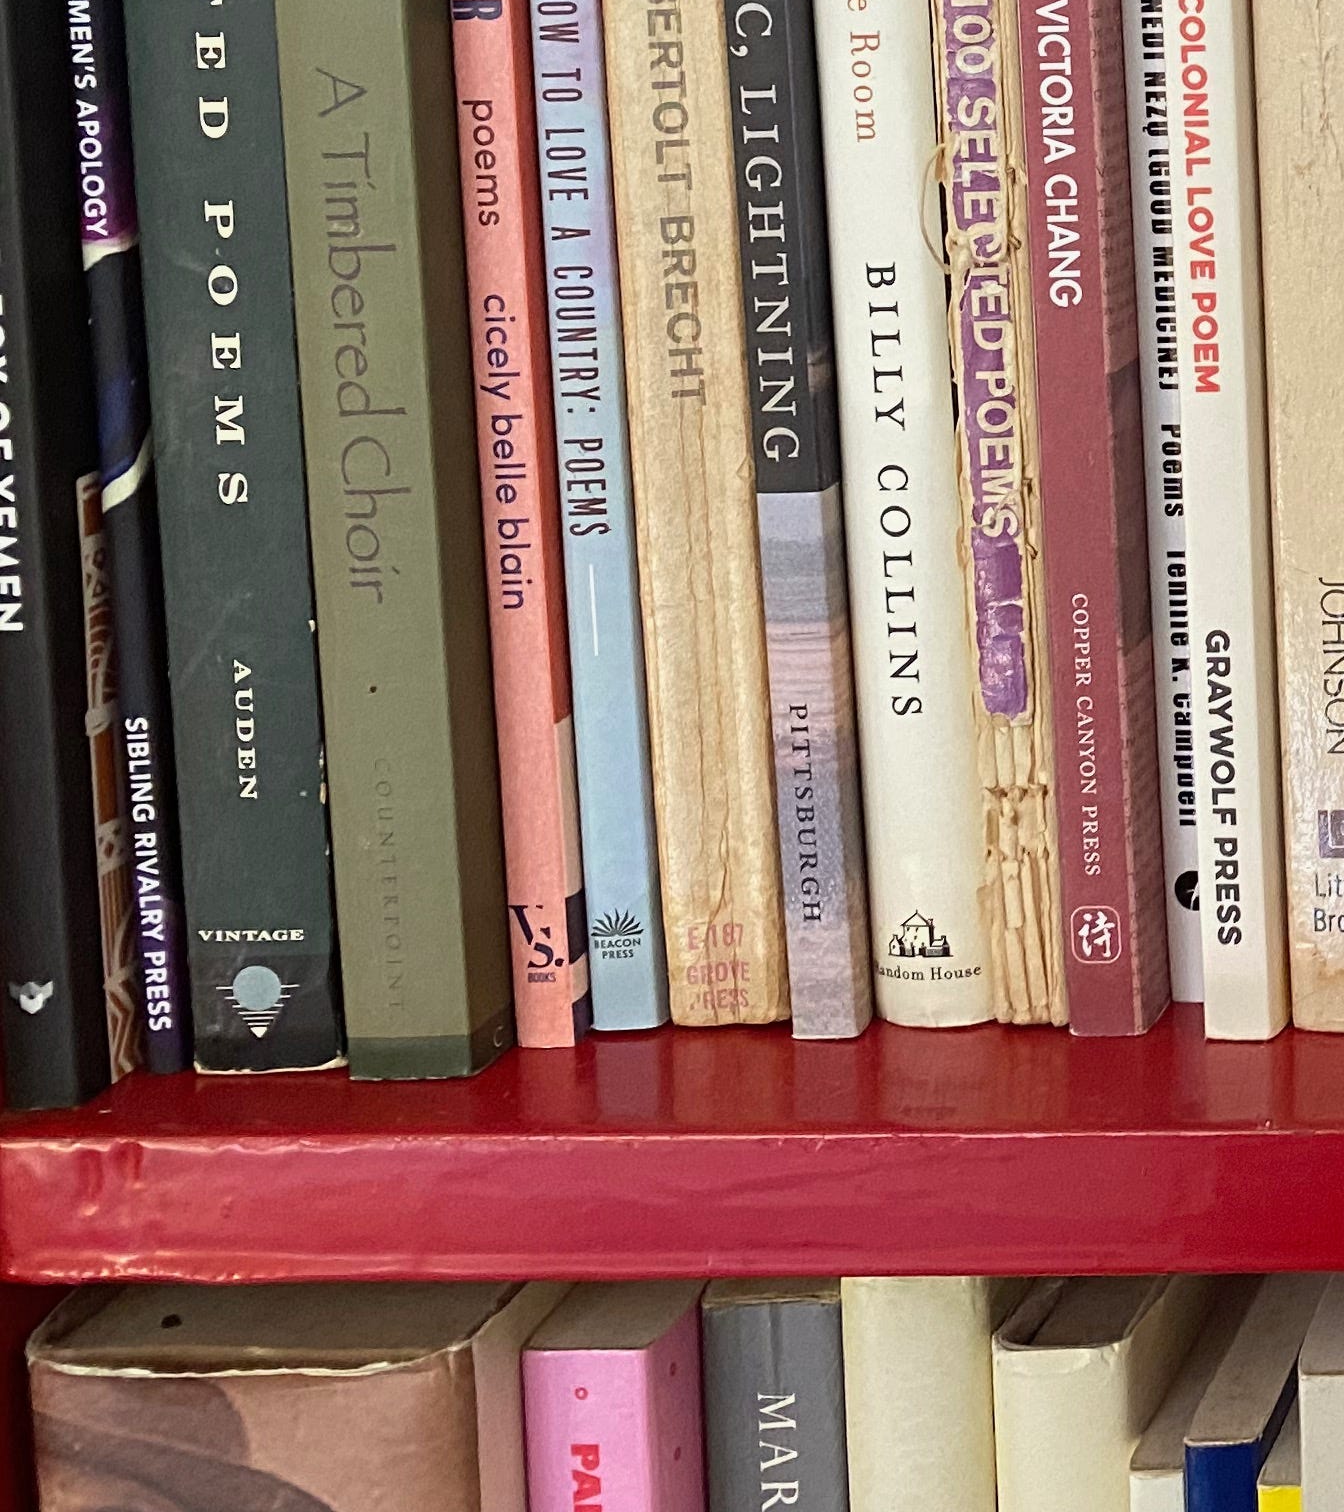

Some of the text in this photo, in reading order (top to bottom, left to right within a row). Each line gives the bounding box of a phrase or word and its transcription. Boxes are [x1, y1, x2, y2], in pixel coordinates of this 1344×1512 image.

[77, 98, 108, 239] APOLOGY
[464, 98, 500, 227] poems
[850, 30, 878, 143] Room
[660, 216, 705, 404] BRECHT
[738, 85, 802, 461] LIGHTNING
[1043, 174, 1083, 308] CHANG
[1187, 187, 1215, 279] LOVE
[321, 132, 411, 606] Timbered Choir
[1192, 292, 1220, 393] POEM
[203, 200, 249, 506] POEMS
[233, 659, 257, 800] AUDEN
[483, 293, 533, 610] cicely belle blain
[564, 437, 610, 536] POEMS
[866, 261, 923, 717] BILLY COLLINS
[975, 369, 1022, 540] POEMS
[790, 703, 823, 924] PITTSBURGH
[1070, 592, 1100, 877] COPPER CANYON PRESS
[1205, 629, 1241, 946] GRAYWOLF PRESS
[198, 928, 304, 942] VINTAGE
[594, 939, 640, 948] BEACON
